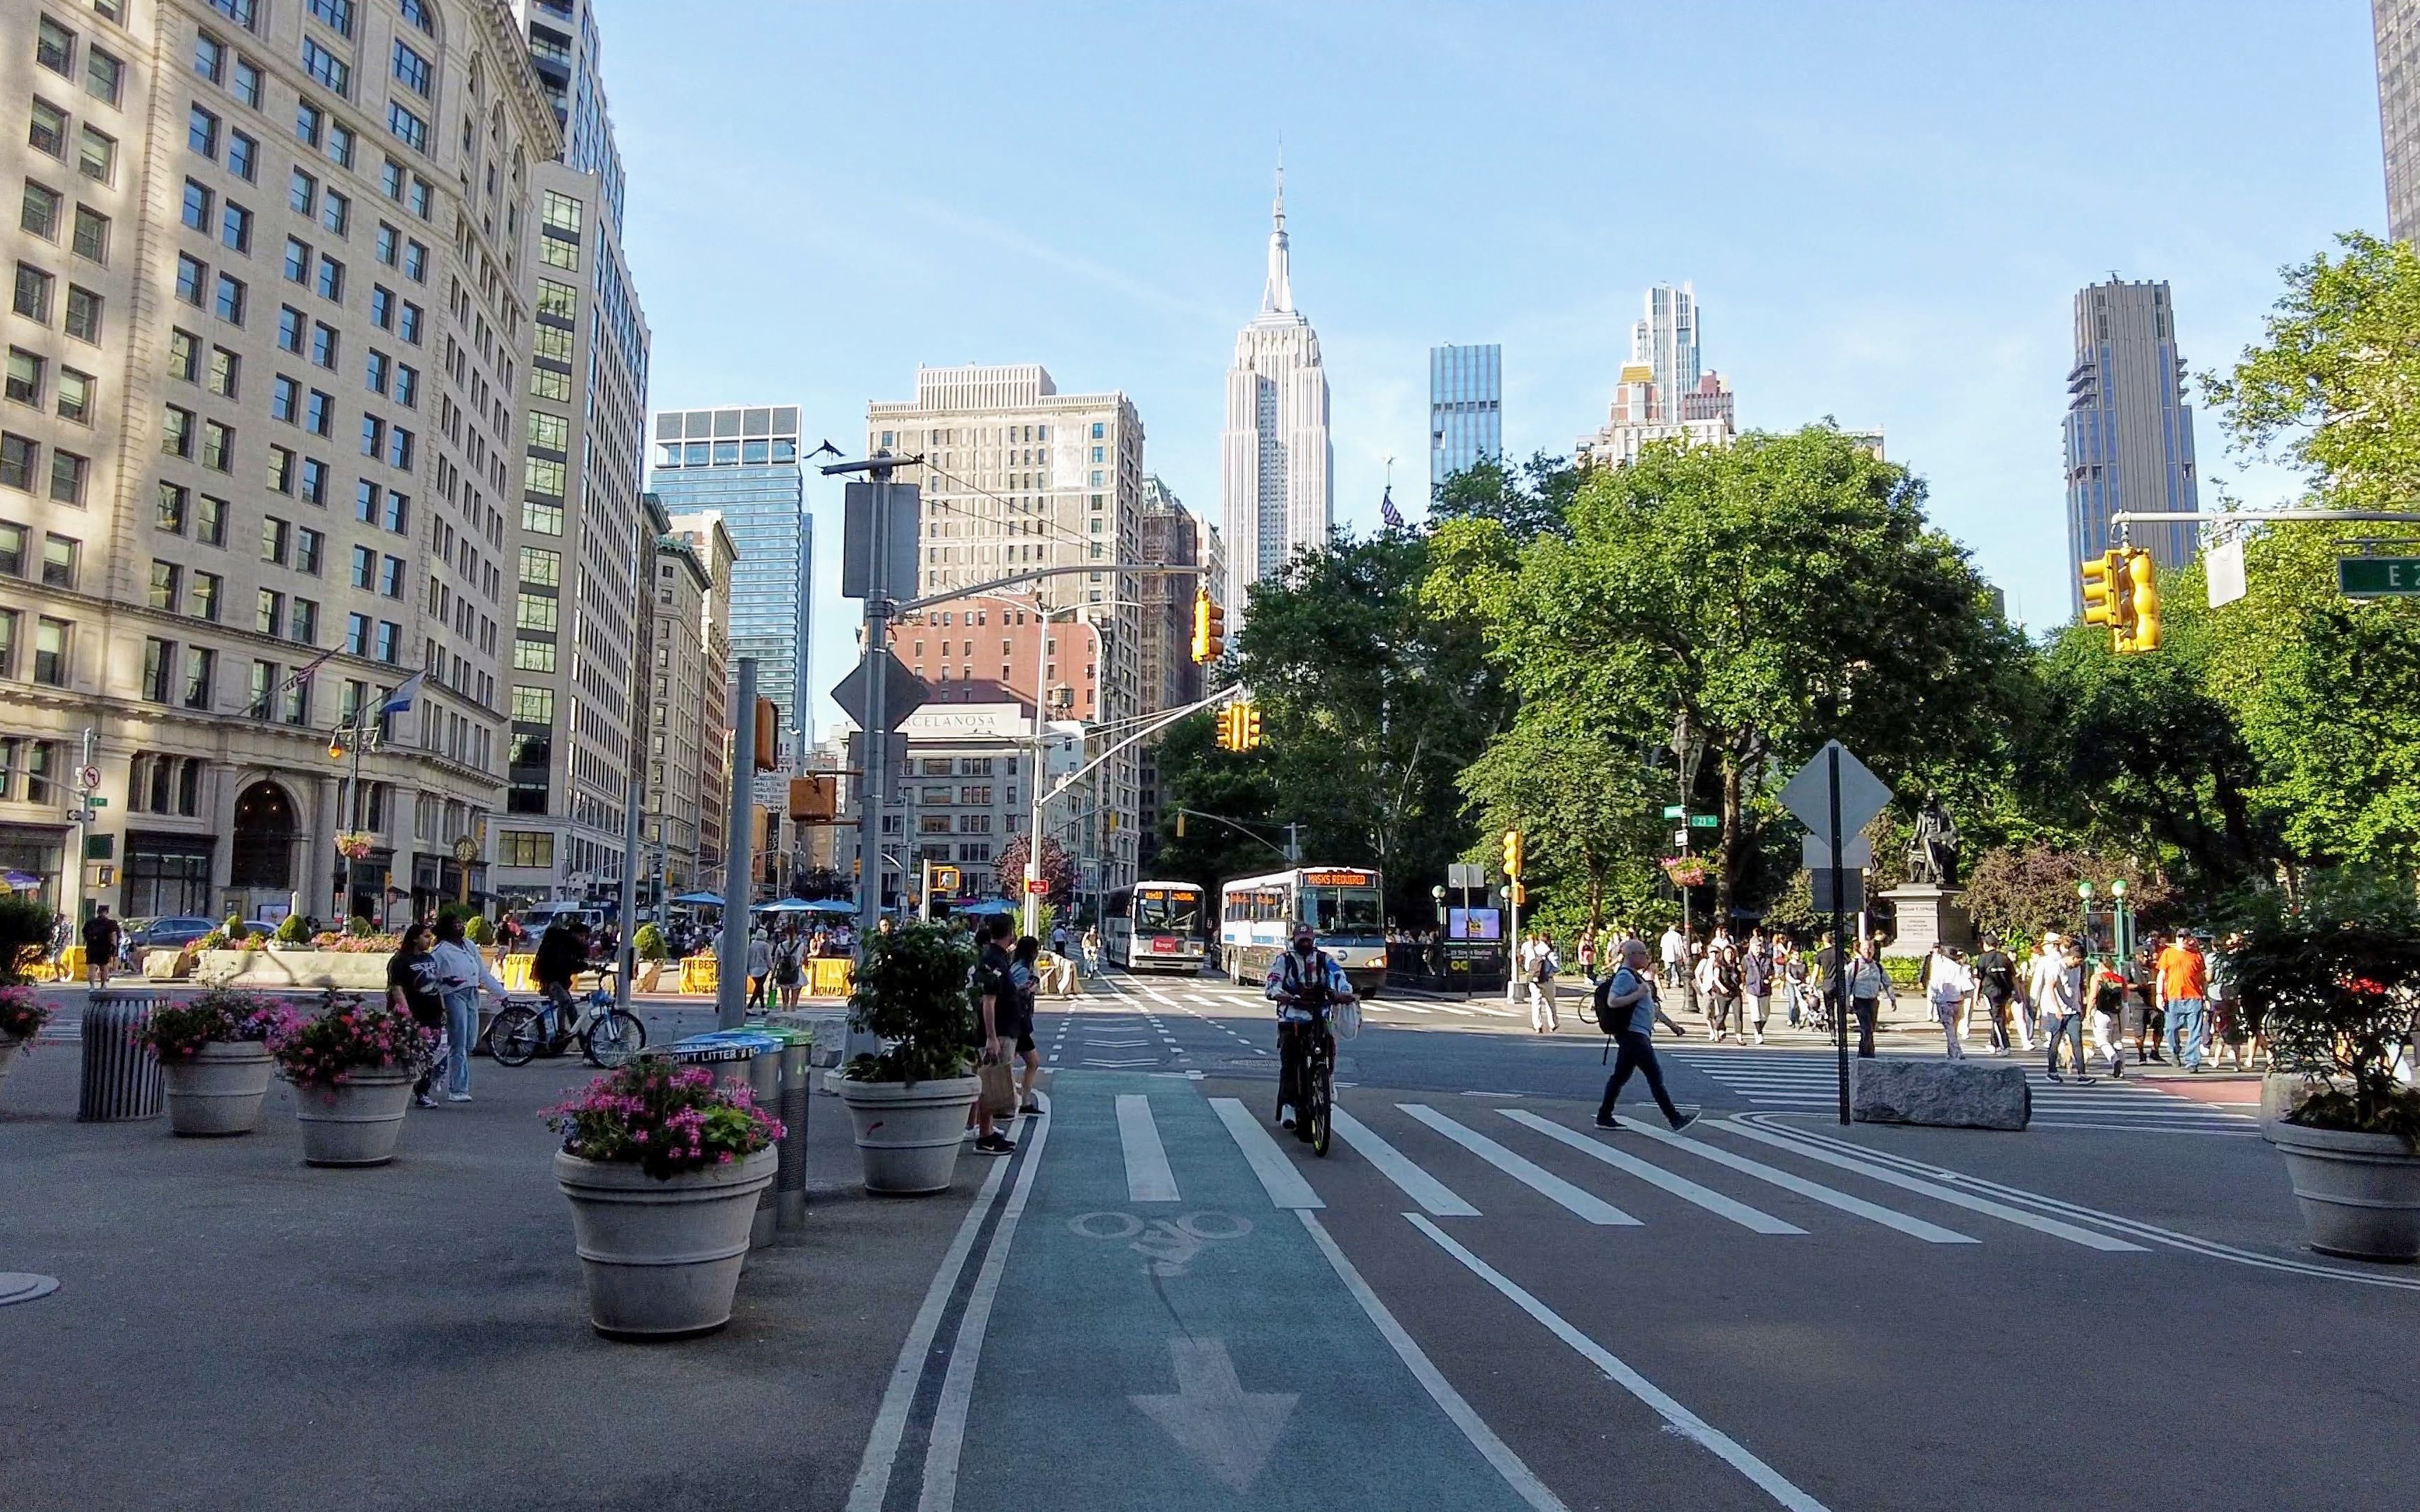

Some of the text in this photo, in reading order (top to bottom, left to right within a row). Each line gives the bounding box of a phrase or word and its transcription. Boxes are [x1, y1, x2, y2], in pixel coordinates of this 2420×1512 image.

[2388, 565, 2401, 587] E
[903, 715, 995, 727] RCELANOSA
[1308, 874, 1365, 885] MASKS REQUIRED
[812, 986, 843, 996] NOMAD
[702, 1049, 736, 1062] LITTER
